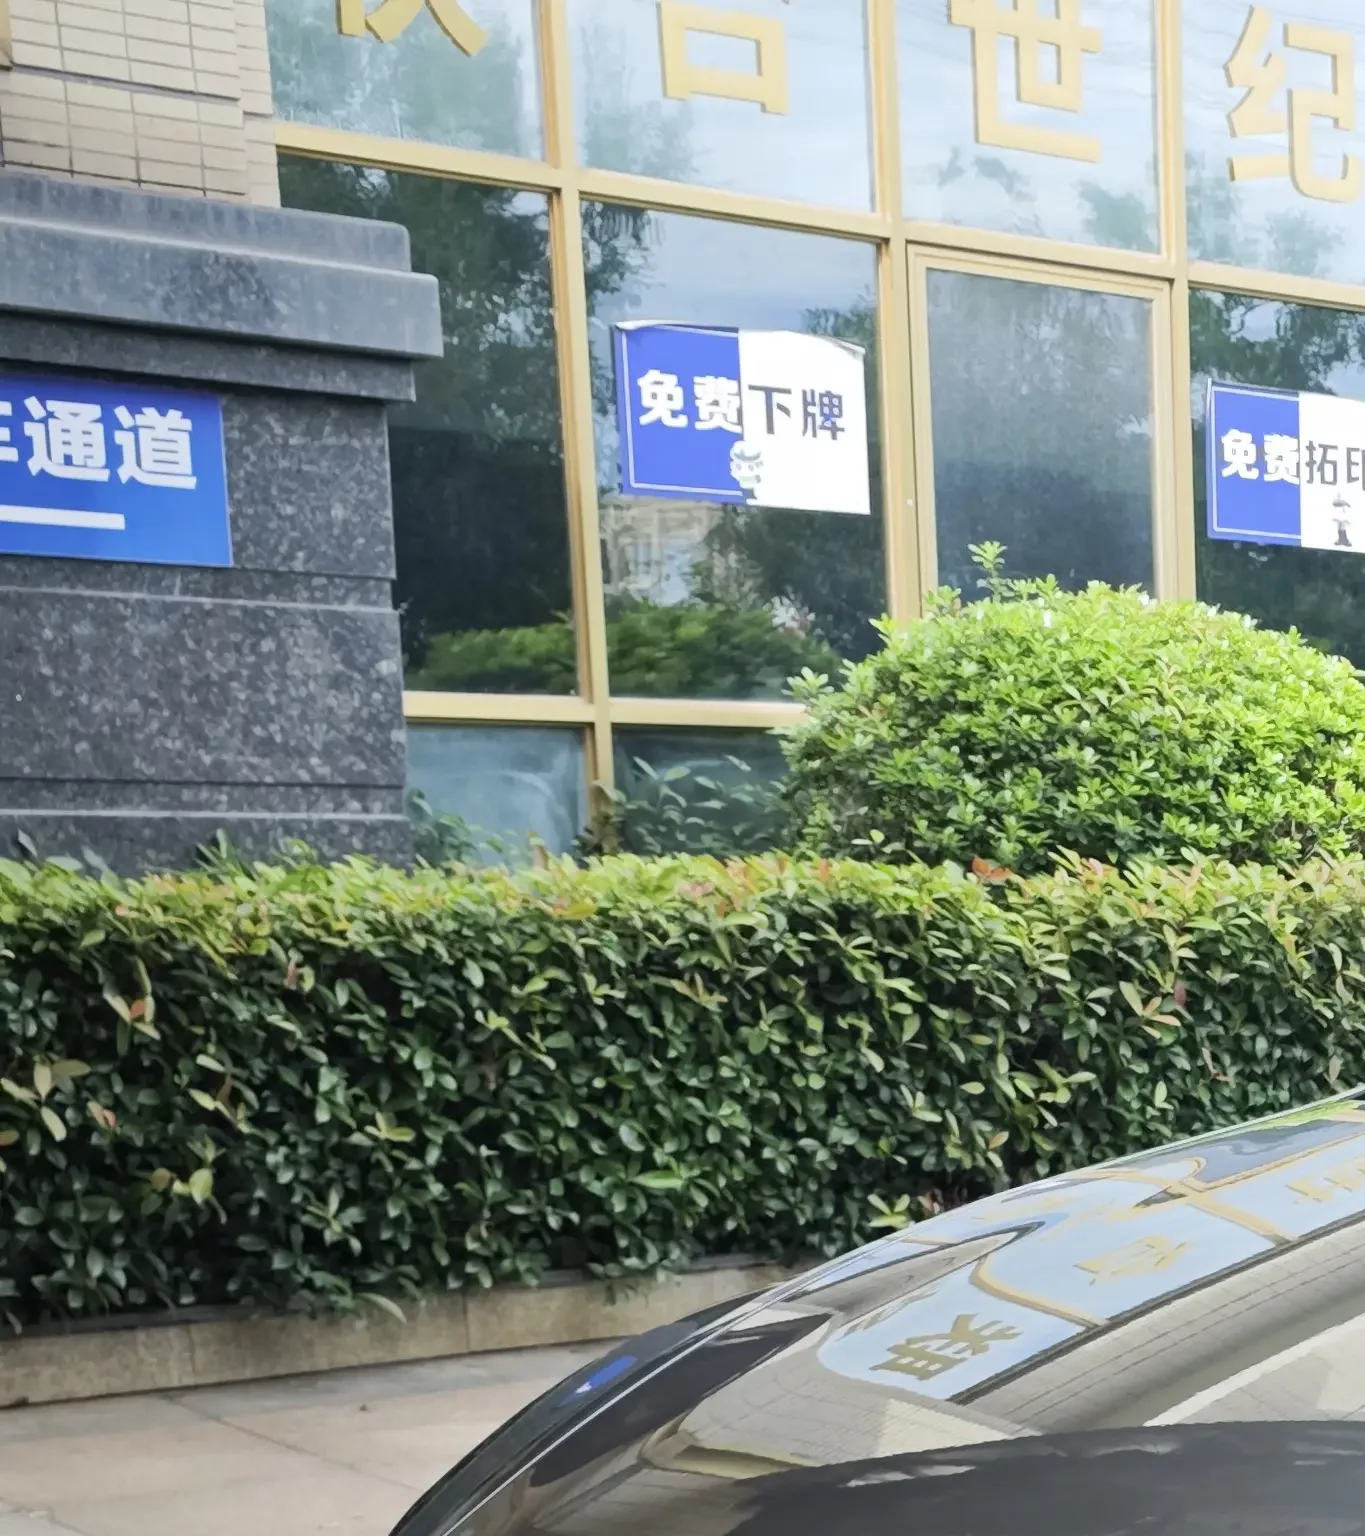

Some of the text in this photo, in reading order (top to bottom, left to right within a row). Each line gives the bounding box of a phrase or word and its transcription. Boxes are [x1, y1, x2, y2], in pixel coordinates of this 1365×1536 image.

[0, 395, 197, 490] 通道
[638, 368, 847, 443] 免费下牌
